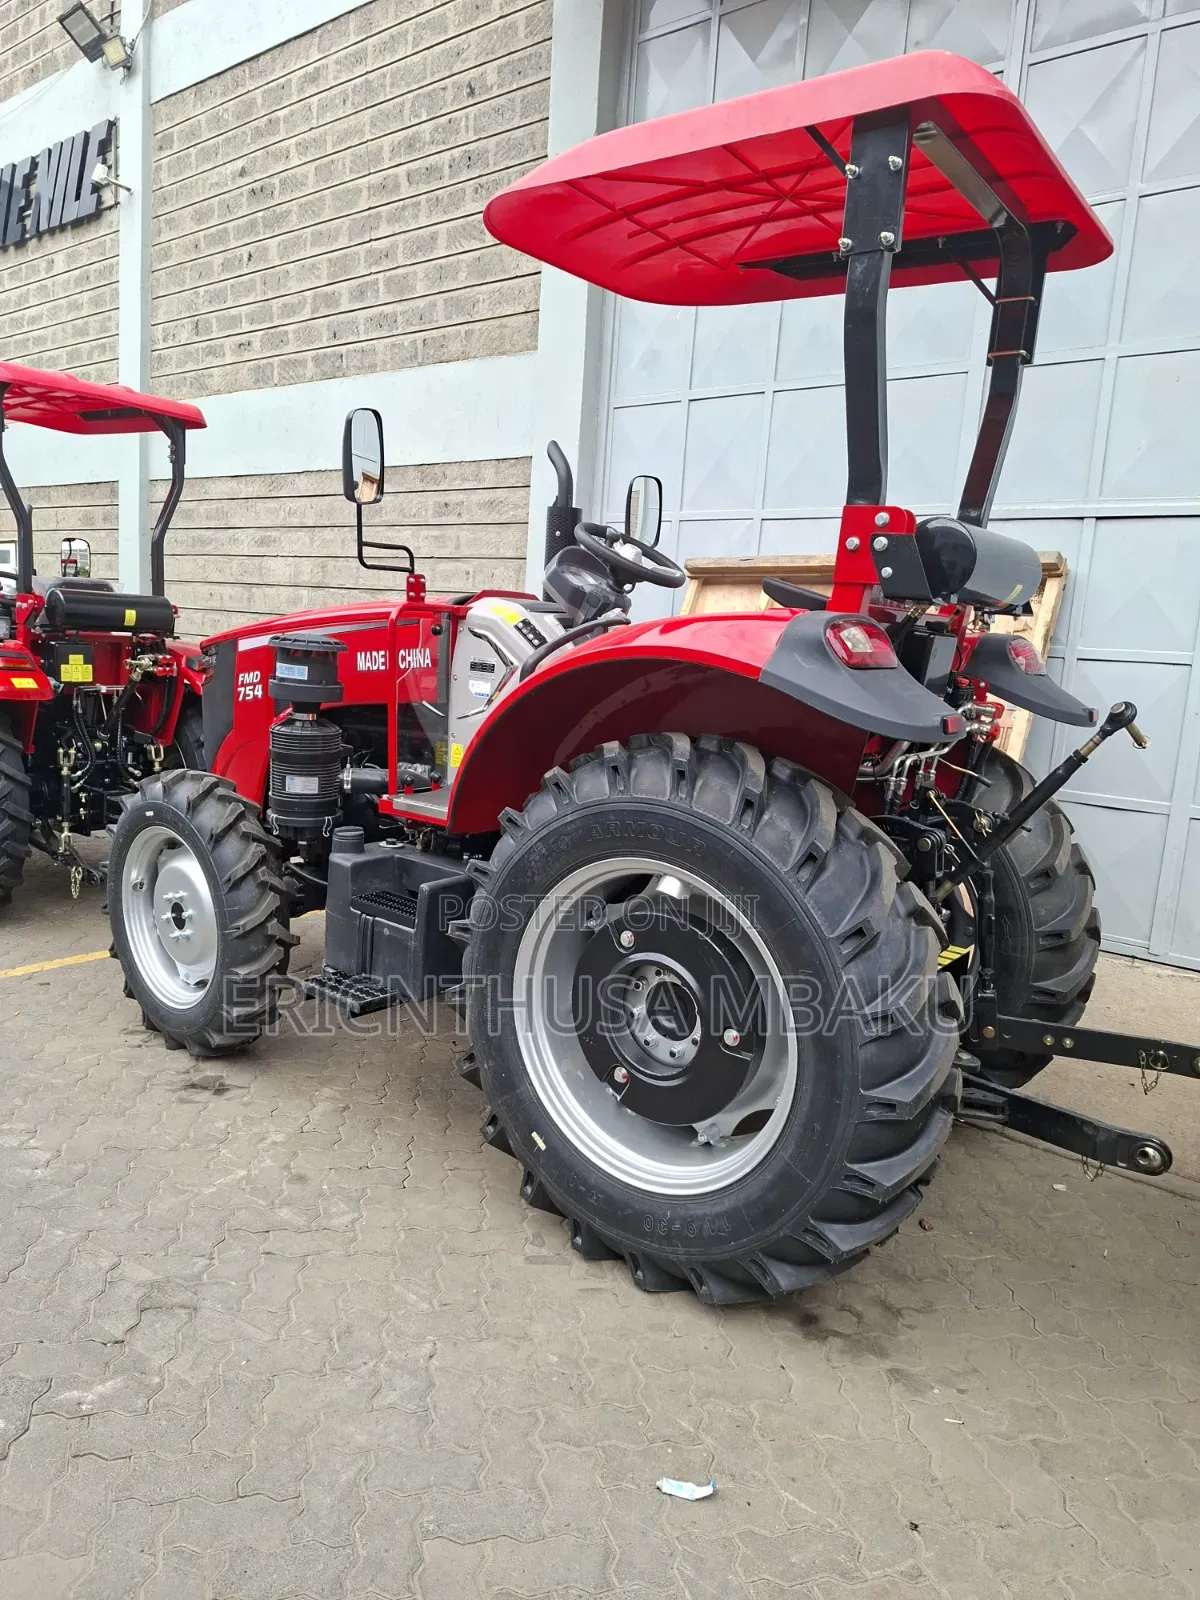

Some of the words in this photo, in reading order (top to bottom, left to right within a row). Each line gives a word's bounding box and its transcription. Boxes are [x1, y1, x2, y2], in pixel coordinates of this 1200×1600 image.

[28, 119, 114, 236] NILE
[357, 650, 386, 671] MADE
[398, 647, 432, 669] CHINA
[237, 684, 263, 702] 754
[586, 820, 707, 857] ARMOUR
